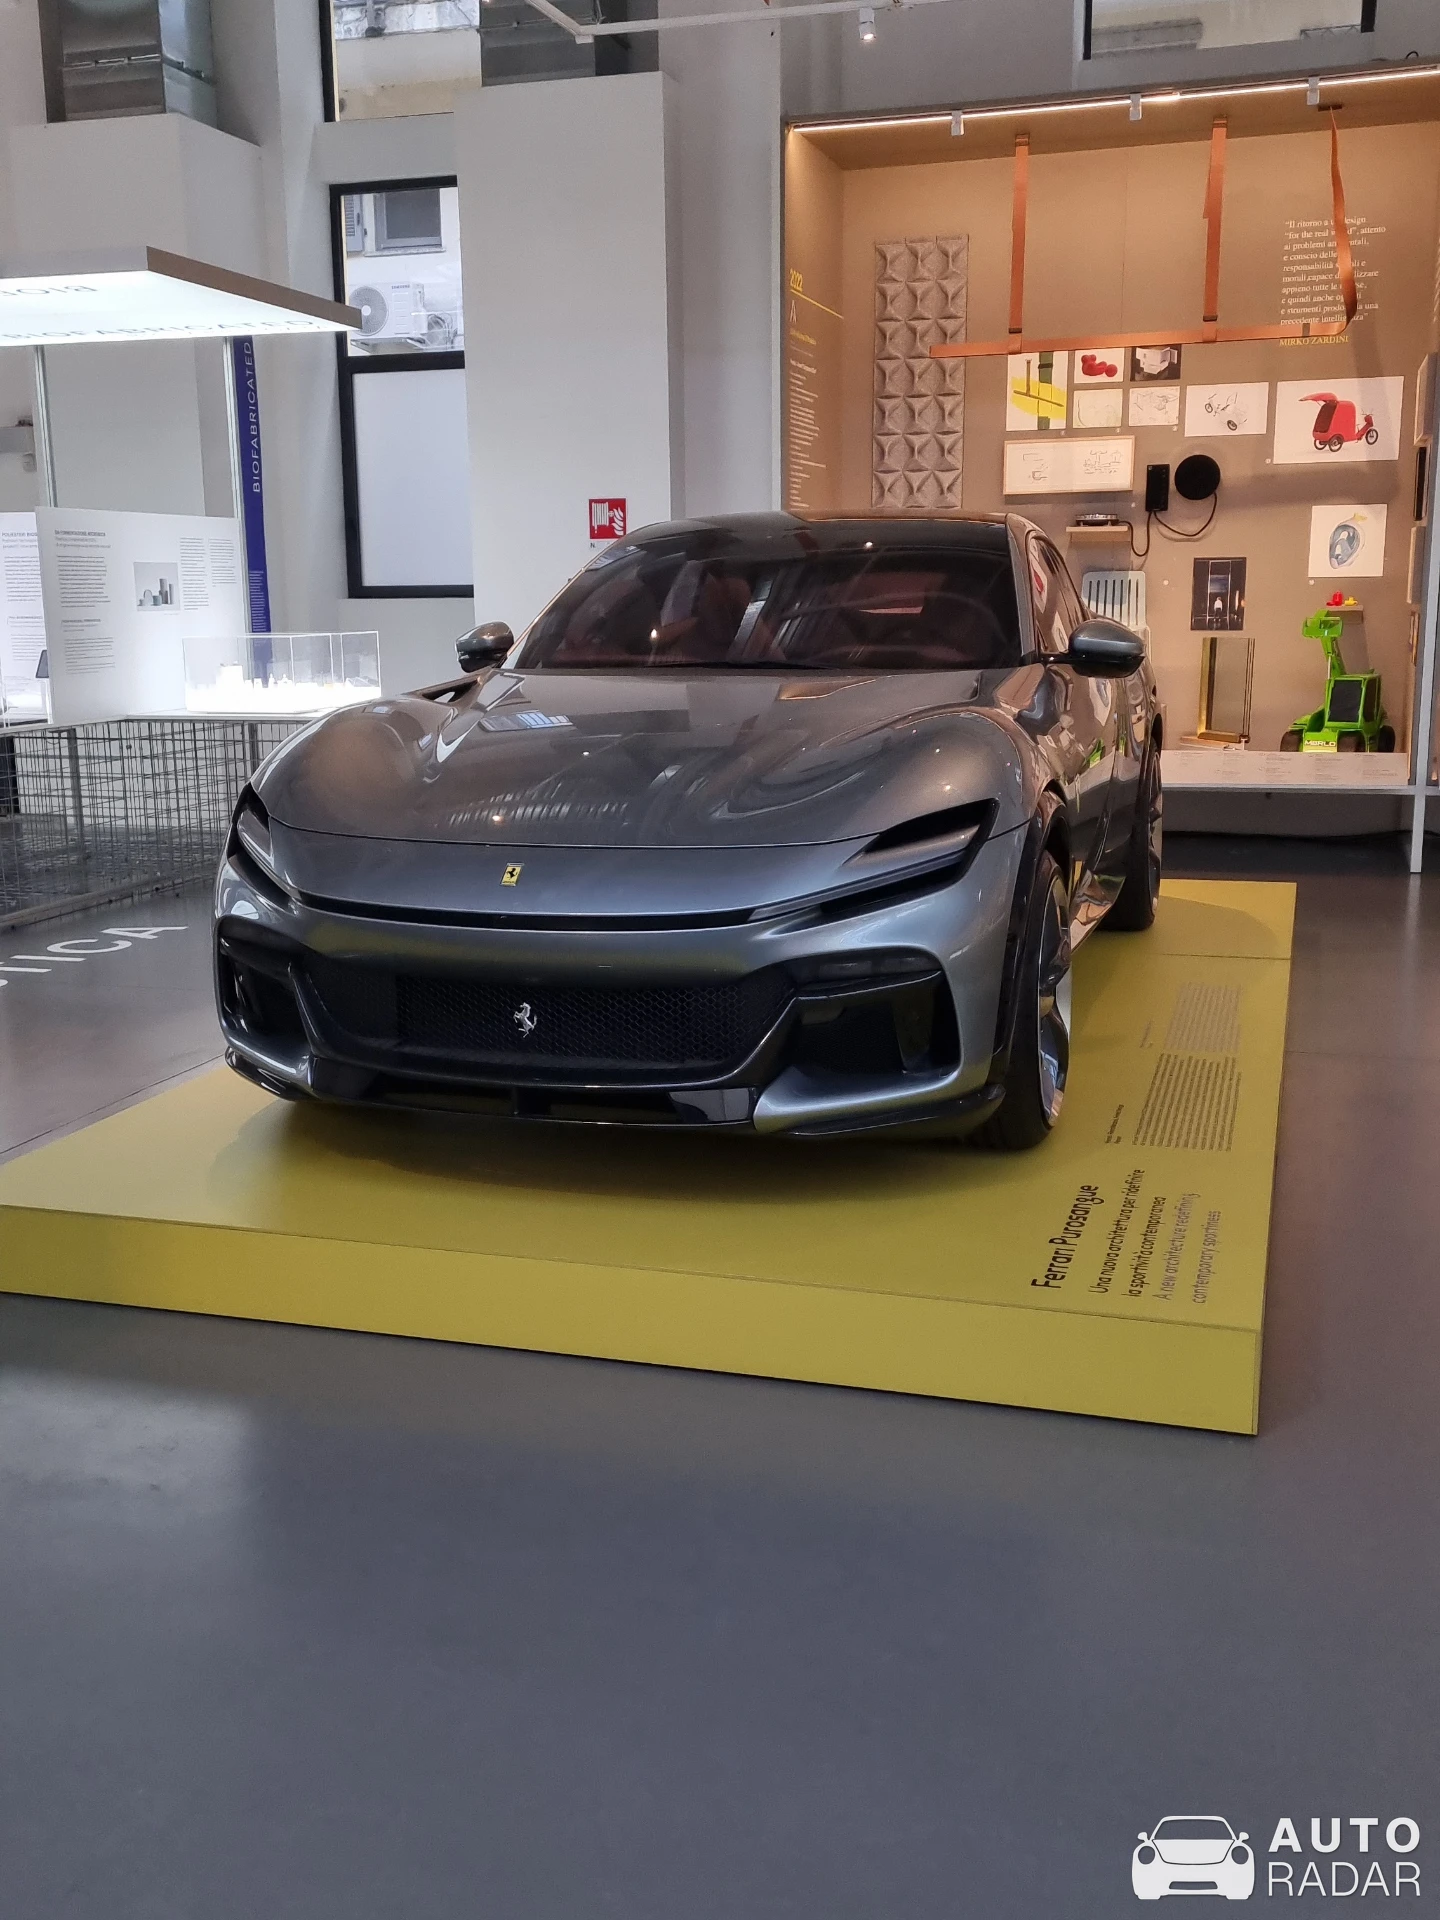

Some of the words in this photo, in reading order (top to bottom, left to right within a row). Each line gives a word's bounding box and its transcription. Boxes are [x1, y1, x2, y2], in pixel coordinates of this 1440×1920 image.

[1297, 220, 1322, 228] ritorno
[1301, 230, 1313, 238] the
[1314, 229, 1329, 237] real
[1360, 226, 1386, 234] attento
[1283, 242, 1291, 250] ai
[1292, 240, 1325, 251] problemi
[1289, 253, 1318, 261] conscio
[1319, 250, 1338, 258] delle
[1283, 261, 1334, 272] responsabilità
[1282, 285, 1311, 295] appieno
[1312, 283, 1329, 291] tutte
[1331, 282, 1338, 290] le
[1287, 295, 1311, 304] quindi
[1313, 294, 1334, 302] anche
[1287, 305, 1321, 314] strumenti
[1281, 316, 1319, 325] precedente
[1279, 338, 1309, 346] MIRKO
[1311, 335, 1349, 345] ZARDINI
[243, 341, 261, 493] BIOFABRICATED
[0, 926, 188, 987] TICA
[1120, 1169, 1145, 1197] ridefinire
[1121, 1196, 1139, 1209] per
[1174, 1193, 1201, 1227] redefining
[1048, 1185, 1105, 1246] Purosangue
[1139, 1196, 1168, 1249] contemporanea
[1107, 1209, 1133, 1252] architettura
[1201, 1210, 1221, 1247] sportiness
[1161, 1227, 1186, 1274] architecture
[1030, 1248, 1076, 1289] Ferrari
[1100, 1252, 1121, 1276] nuova
[1130, 1249, 1153, 1289] sportività
[1158, 1275, 1177, 1292] new
[1192, 1248, 1217, 1304] contemporary
[1088, 1277, 1112, 1294] Una
[1121, 1289, 1142, 1297] la
[1152, 1293, 1170, 1301] A
